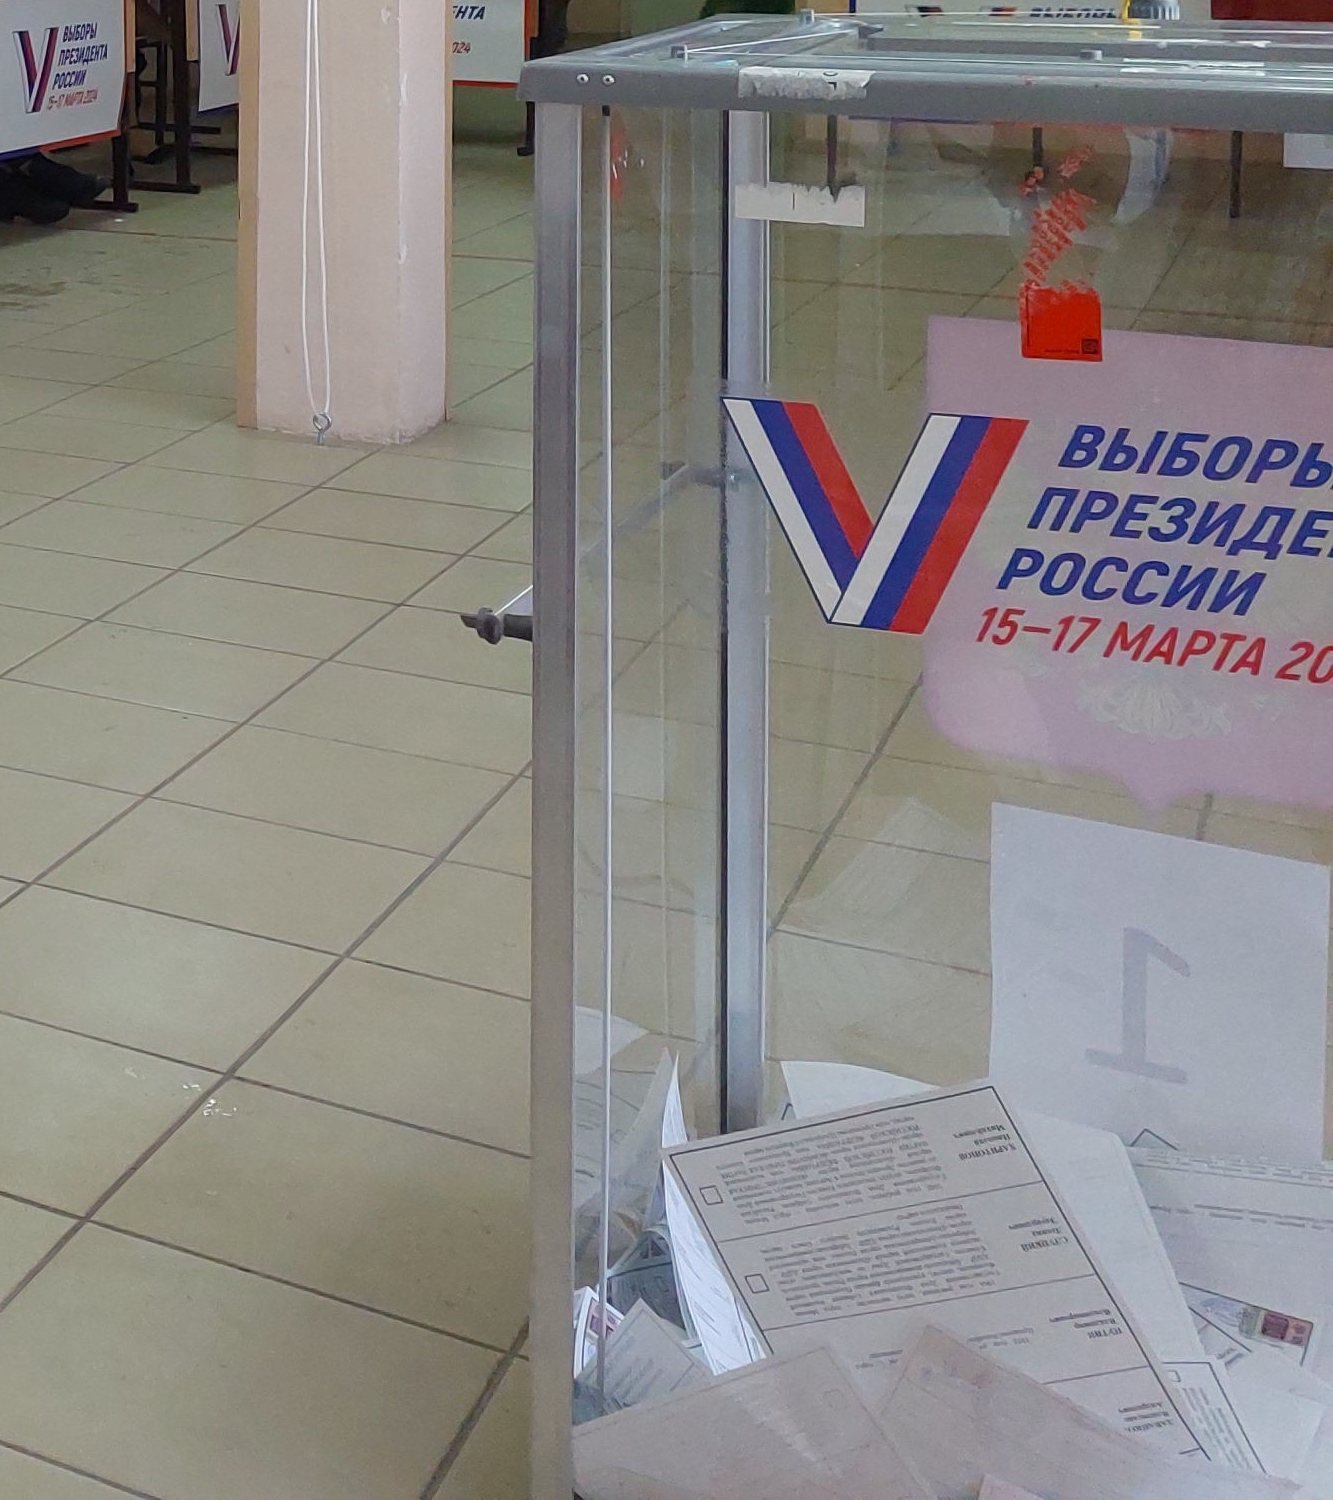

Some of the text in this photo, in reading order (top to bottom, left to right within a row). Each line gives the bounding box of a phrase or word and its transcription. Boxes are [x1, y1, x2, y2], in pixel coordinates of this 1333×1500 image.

[62, 21, 98, 43] ВЫБОРЫ
[57, 43, 108, 67] ПРЕЗИДЕНТА
[52, 69, 87, 90] РОССИИ
[1026, 486, 1333, 561] ПРЕЗИДЕ
[995, 547, 1268, 617] РОССИИ
[1102, 620, 1267, 676] МАРТА
[1274, 640, 1333, 685] 20
